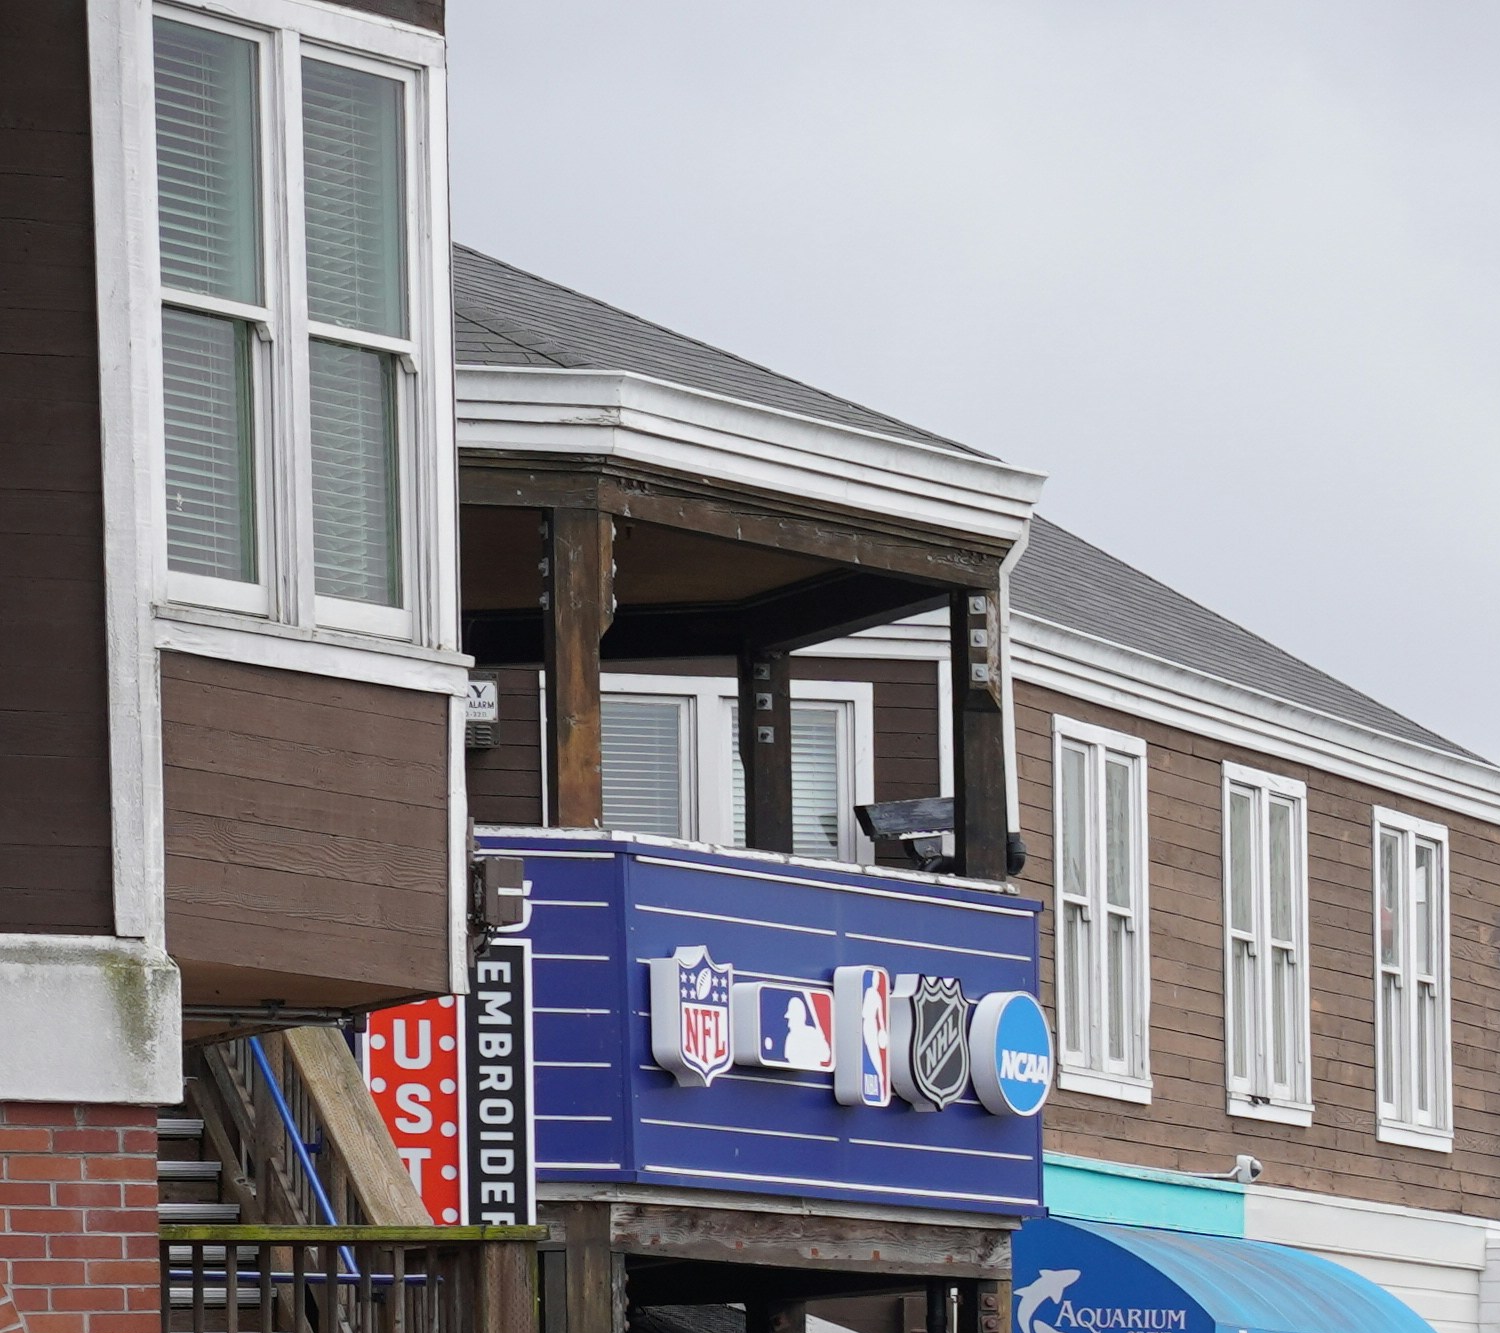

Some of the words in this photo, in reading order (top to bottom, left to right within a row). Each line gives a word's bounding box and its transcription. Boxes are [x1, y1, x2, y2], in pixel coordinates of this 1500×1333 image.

[684, 1007, 726, 1064] NFL
[925, 1019, 958, 1073] NHL
[1000, 1050, 1050, 1085] NCAA
[1055, 1300, 1186, 1332] AQUARIUM
